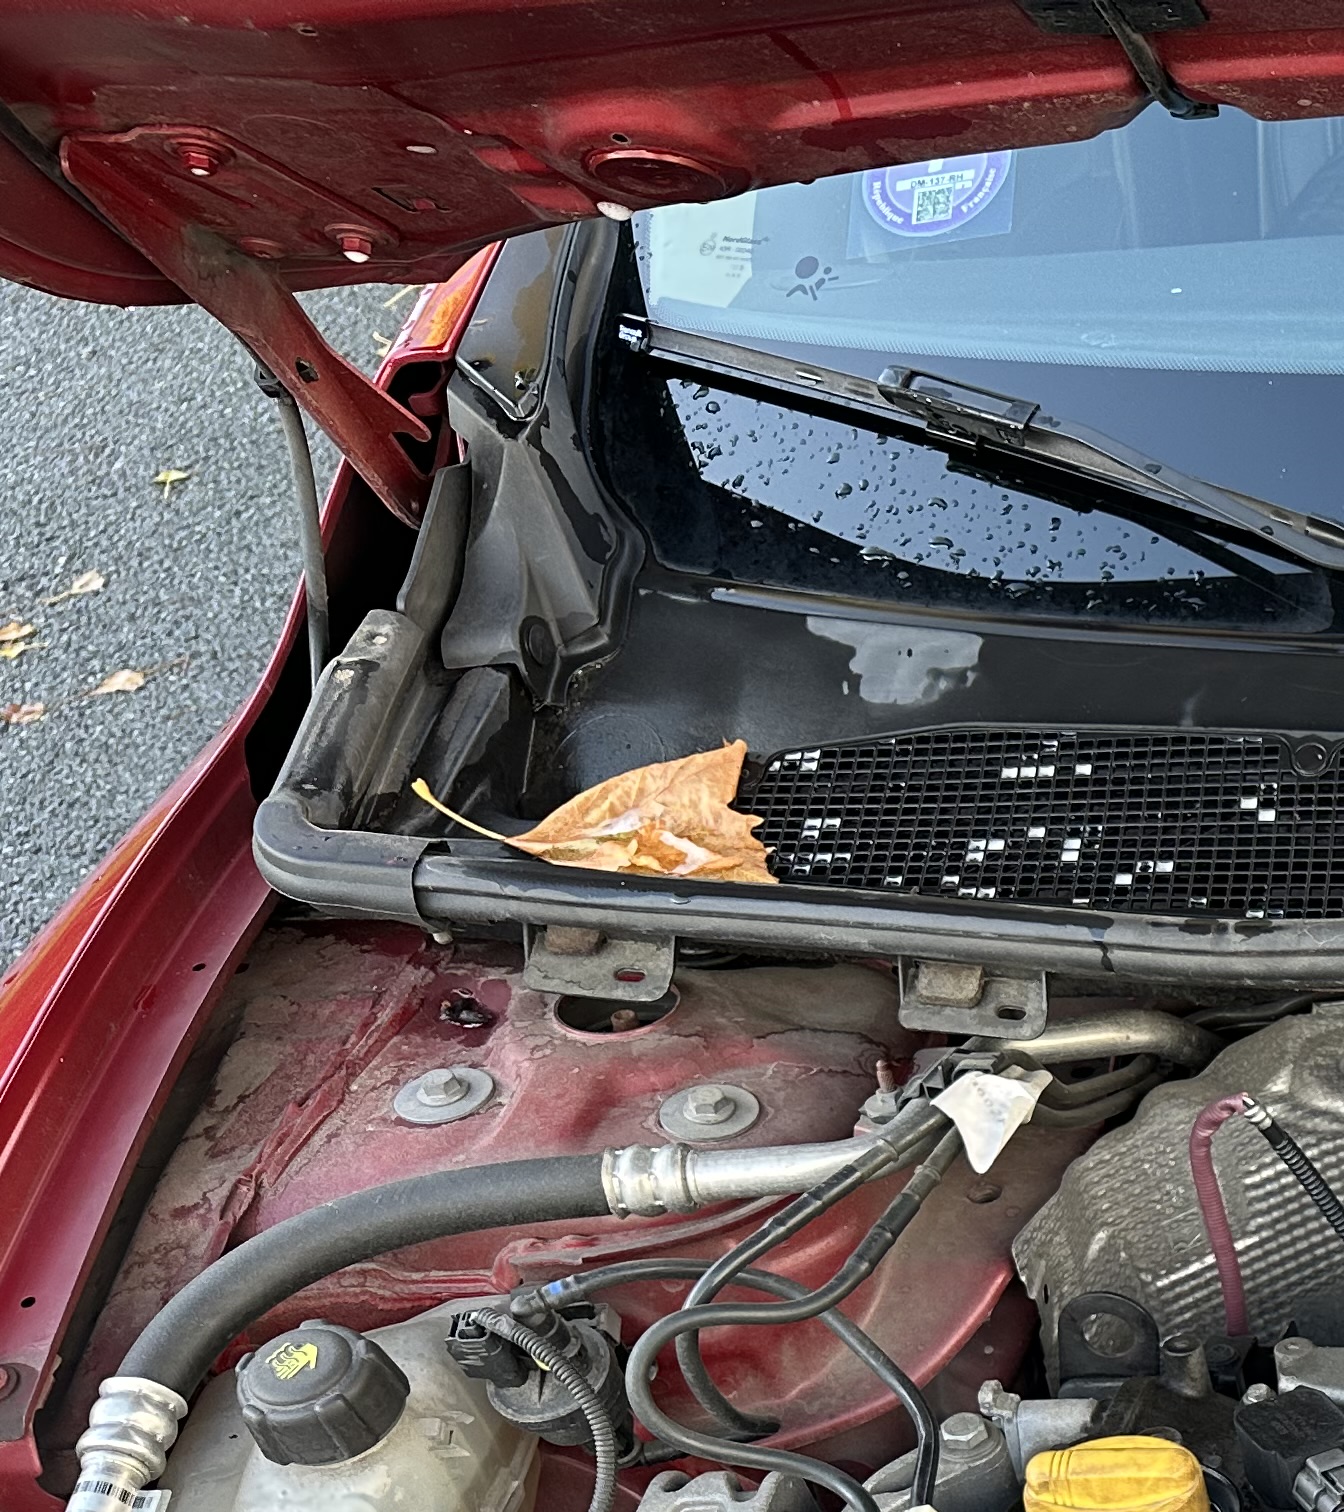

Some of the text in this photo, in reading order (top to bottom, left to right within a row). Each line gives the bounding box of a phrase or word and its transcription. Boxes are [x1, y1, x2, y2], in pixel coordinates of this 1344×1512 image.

[871, 168, 997, 224] République Française
[910, 174, 964, 189] DM-137-RH
